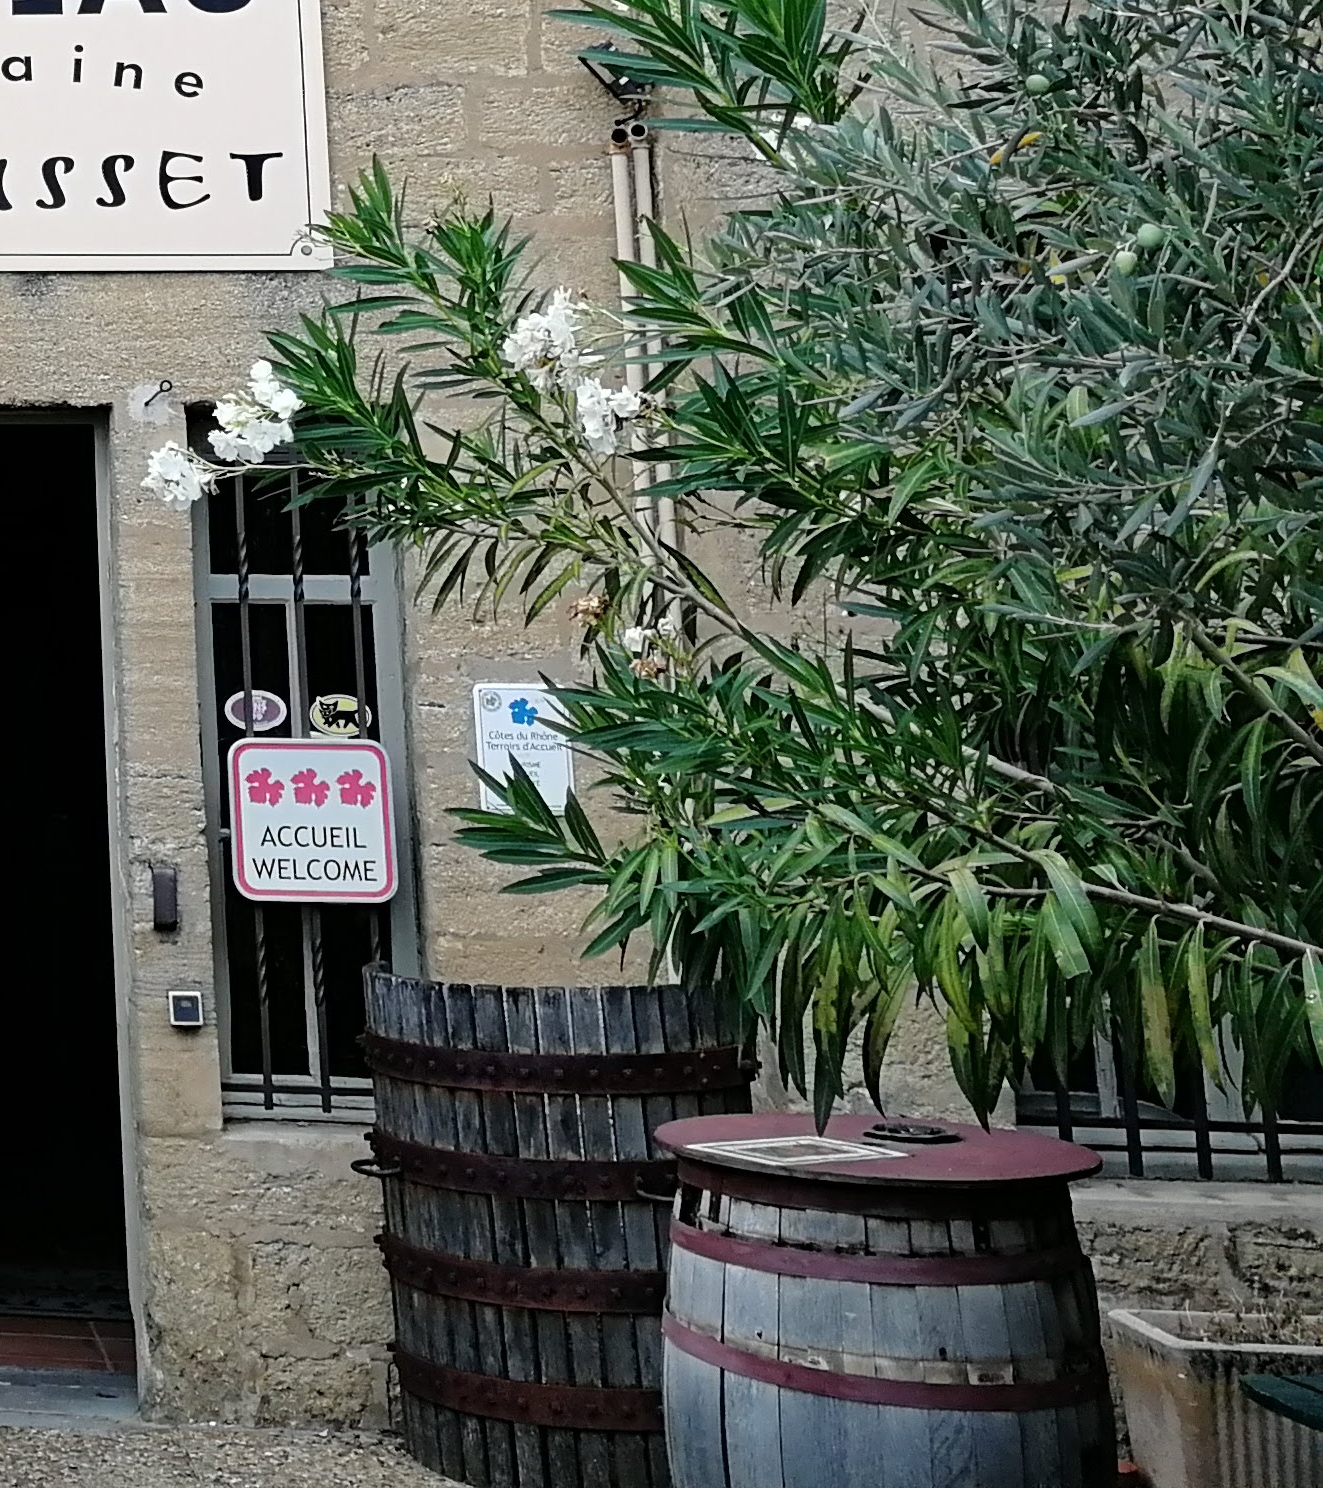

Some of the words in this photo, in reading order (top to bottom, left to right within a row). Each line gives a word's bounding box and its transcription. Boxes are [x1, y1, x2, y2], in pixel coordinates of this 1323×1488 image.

[488, 730, 514, 740] Côtes
[516, 731, 528, 740] du
[530, 731, 558, 741] Rhône
[485, 741, 521, 751] Terroirs
[260, 825, 367, 849] ACCUEIL
[252, 857, 378, 882] WELCOME
